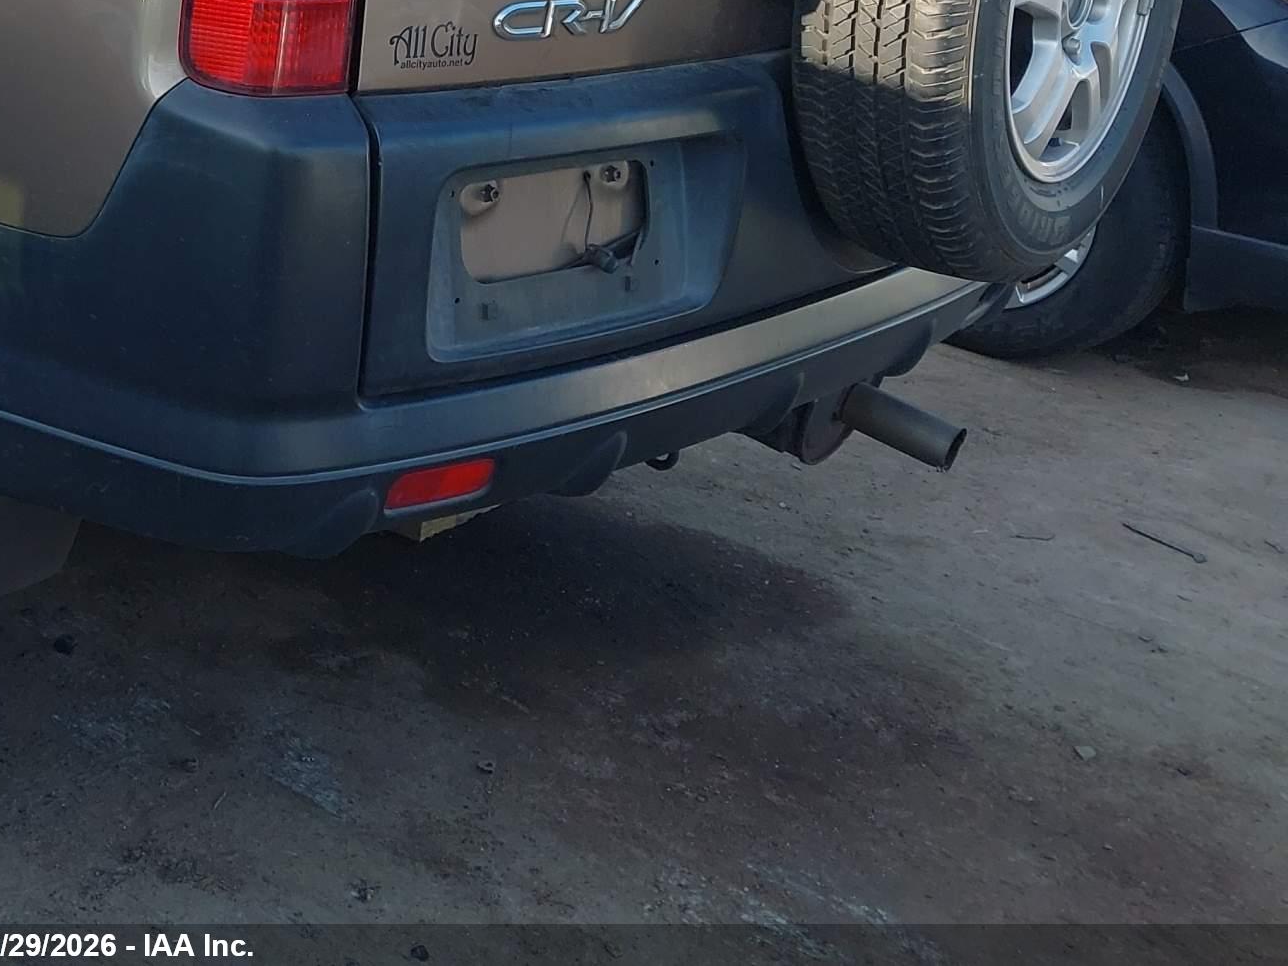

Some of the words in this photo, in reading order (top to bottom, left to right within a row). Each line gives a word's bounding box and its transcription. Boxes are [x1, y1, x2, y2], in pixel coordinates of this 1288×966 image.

[389, 25, 427, 66] All
[431, 20, 478, 66] City
[400, 58, 463, 70] allcityauto.net
